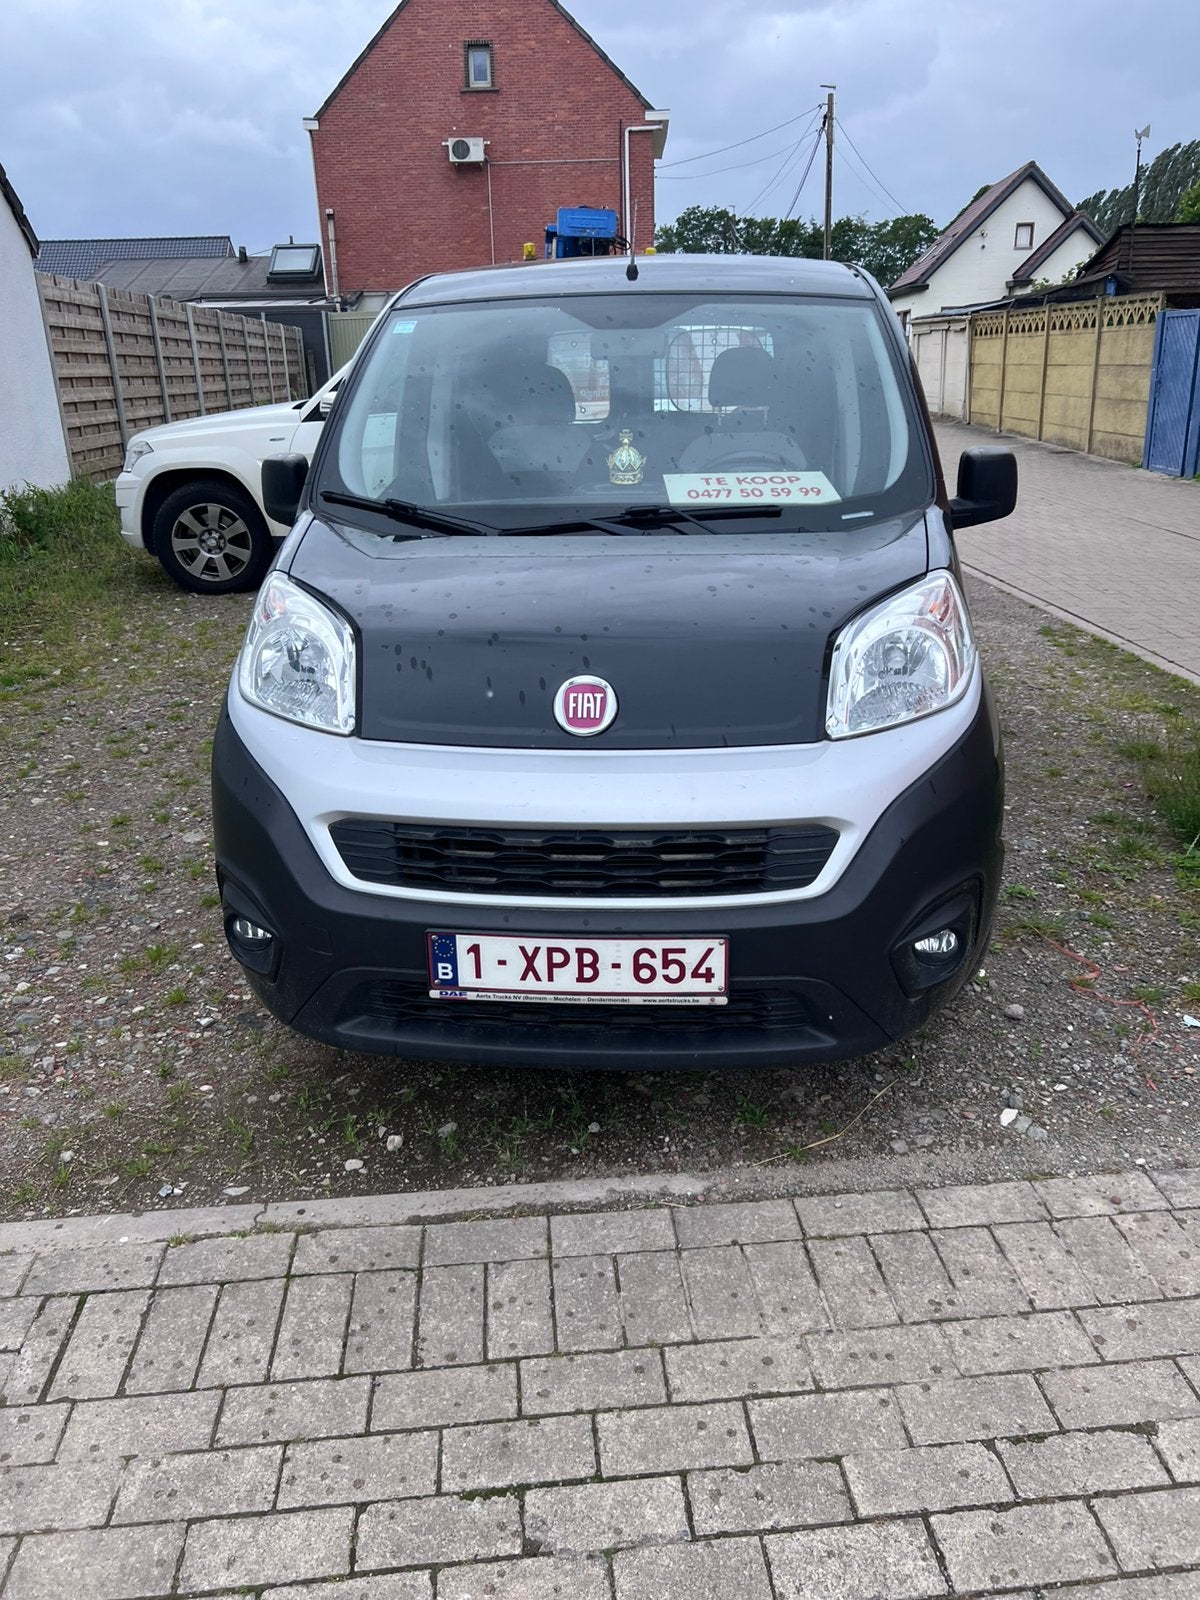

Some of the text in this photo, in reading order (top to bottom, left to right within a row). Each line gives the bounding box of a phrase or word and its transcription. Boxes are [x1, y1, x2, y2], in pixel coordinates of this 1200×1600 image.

[700, 476, 801, 486] TE KOOP
[687, 487, 822, 500] 0477 50 59 99
[568, 692, 604, 719] FIAT
[437, 962, 454, 980] B
